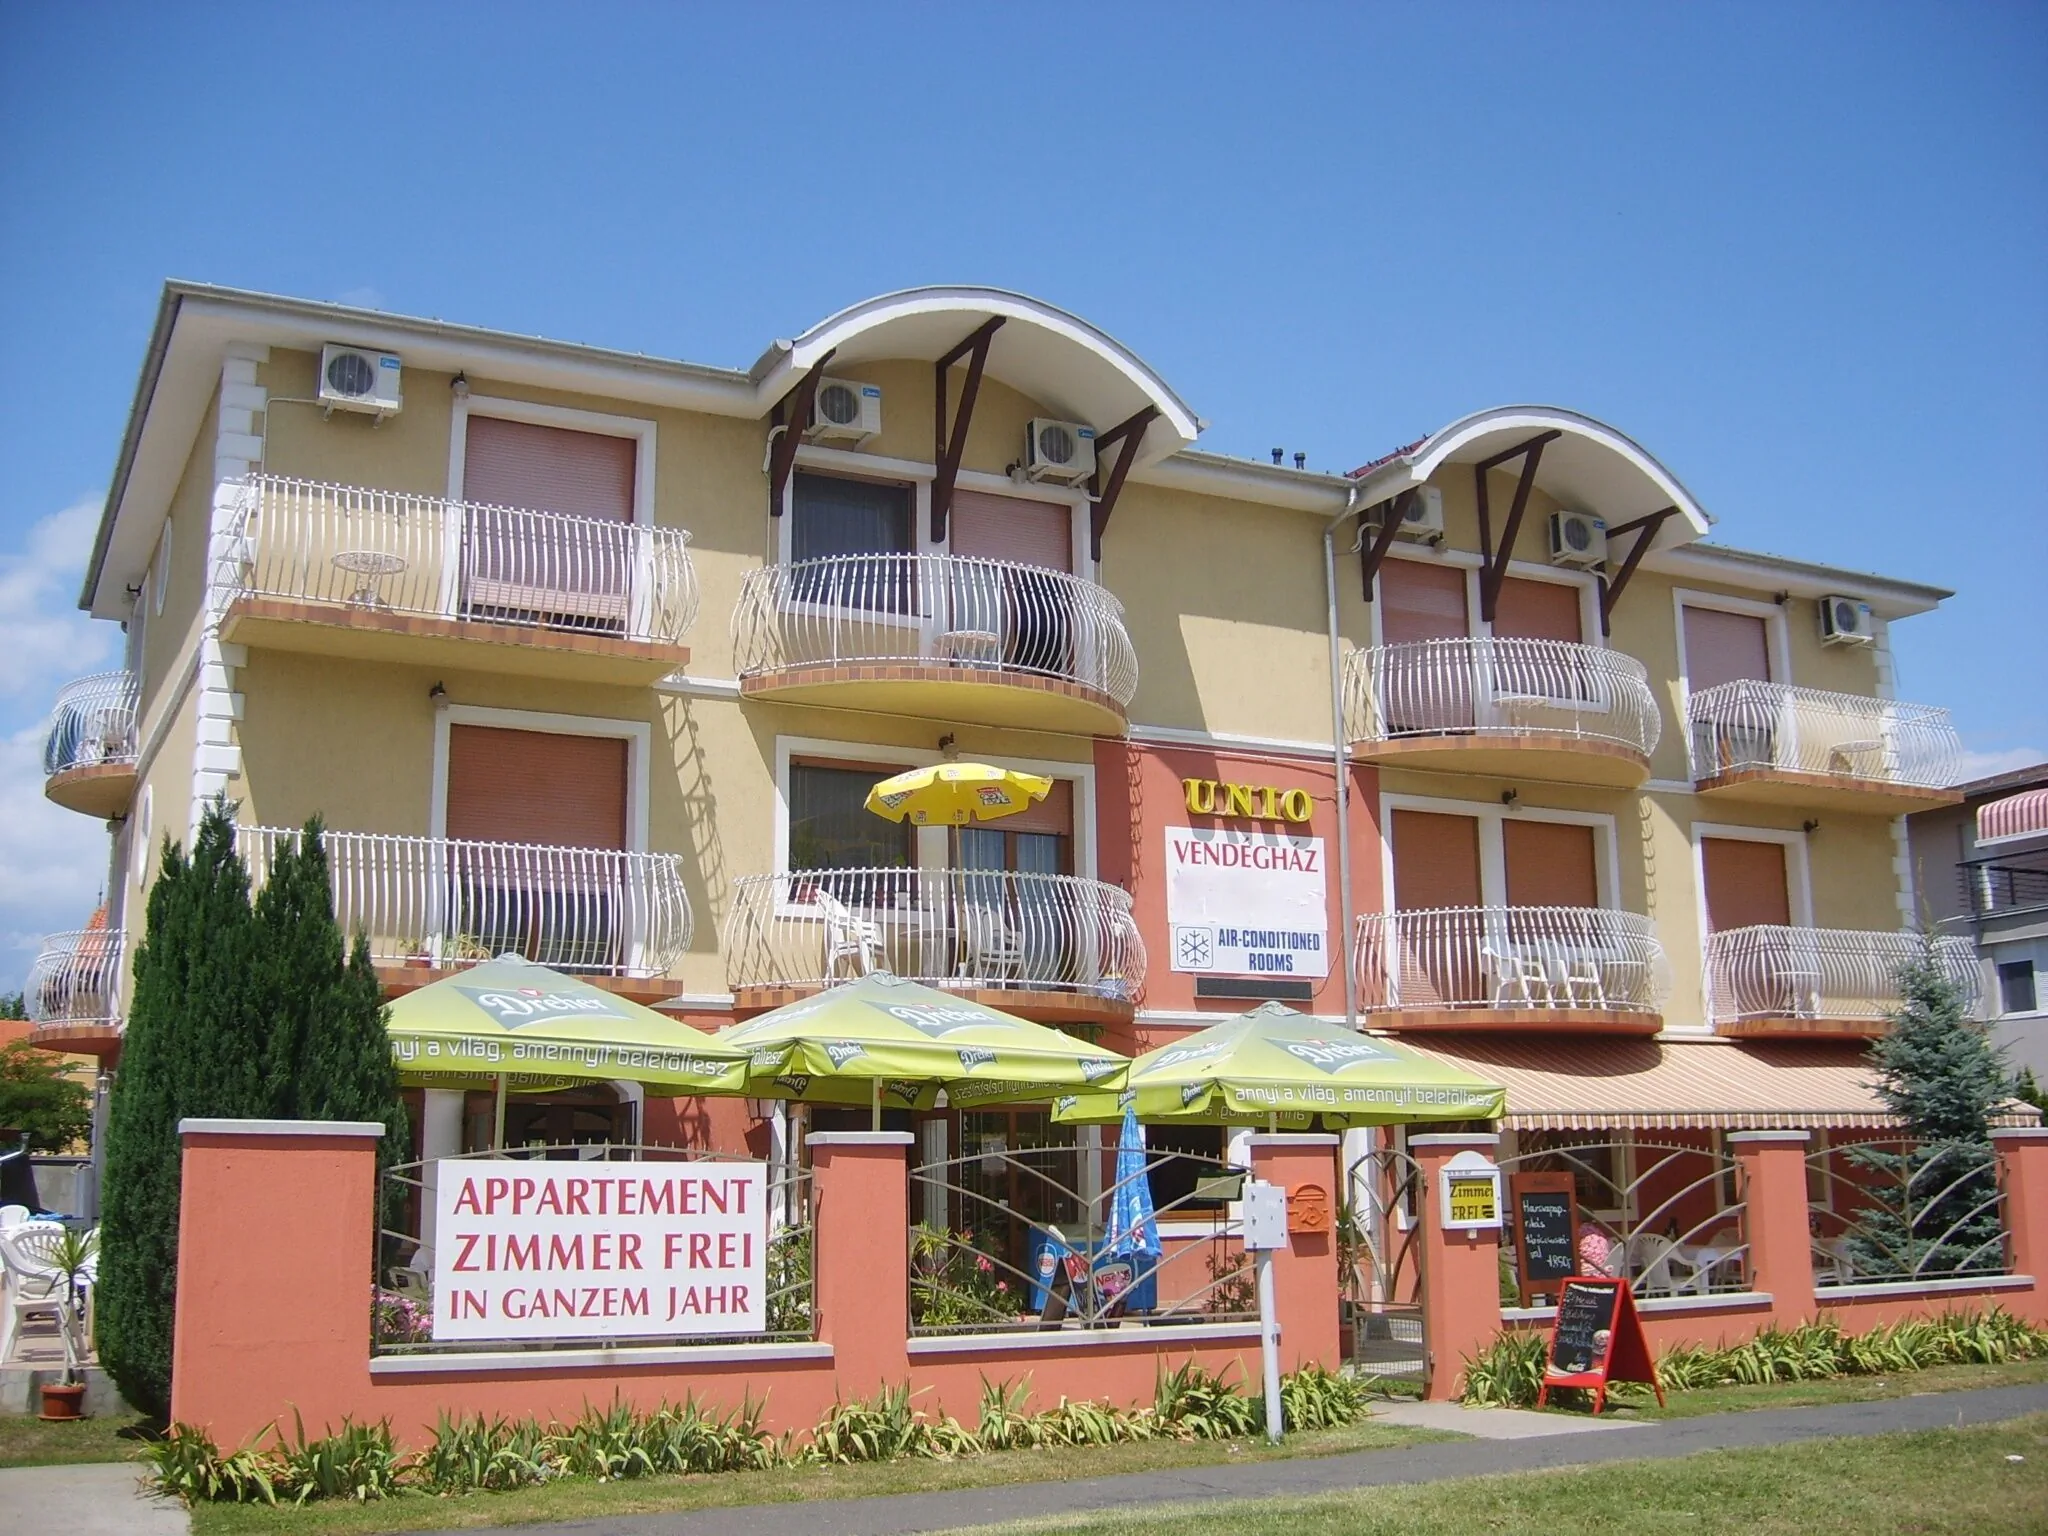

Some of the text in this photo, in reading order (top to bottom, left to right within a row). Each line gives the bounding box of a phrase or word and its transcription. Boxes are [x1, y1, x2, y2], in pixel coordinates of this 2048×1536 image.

[1183, 778, 1313, 822] UNIO
[1174, 836, 1319, 873] VENDÉGHÁZ
[1218, 927, 1320, 951] AIR-CONDITIONED
[1249, 952, 1293, 972] ROOMS
[478, 993, 609, 1017] Dreher
[427, 1040, 441, 1057] a
[448, 1037, 506, 1062] világ,
[513, 1042, 611, 1067] amennyit
[616, 1046, 728, 1077] beletöltesz
[1235, 1084, 1279, 1105] annyi
[1284, 1088, 1294, 1101] a
[1299, 1083, 1340, 1105] világ,
[1343, 1086, 1412, 1107] amennyit
[453, 1176, 753, 1215] APPARTEMENT
[452, 1232, 752, 1272] ZIMMER FREI
[450, 1285, 750, 1322] IN GANZEM JAHR
